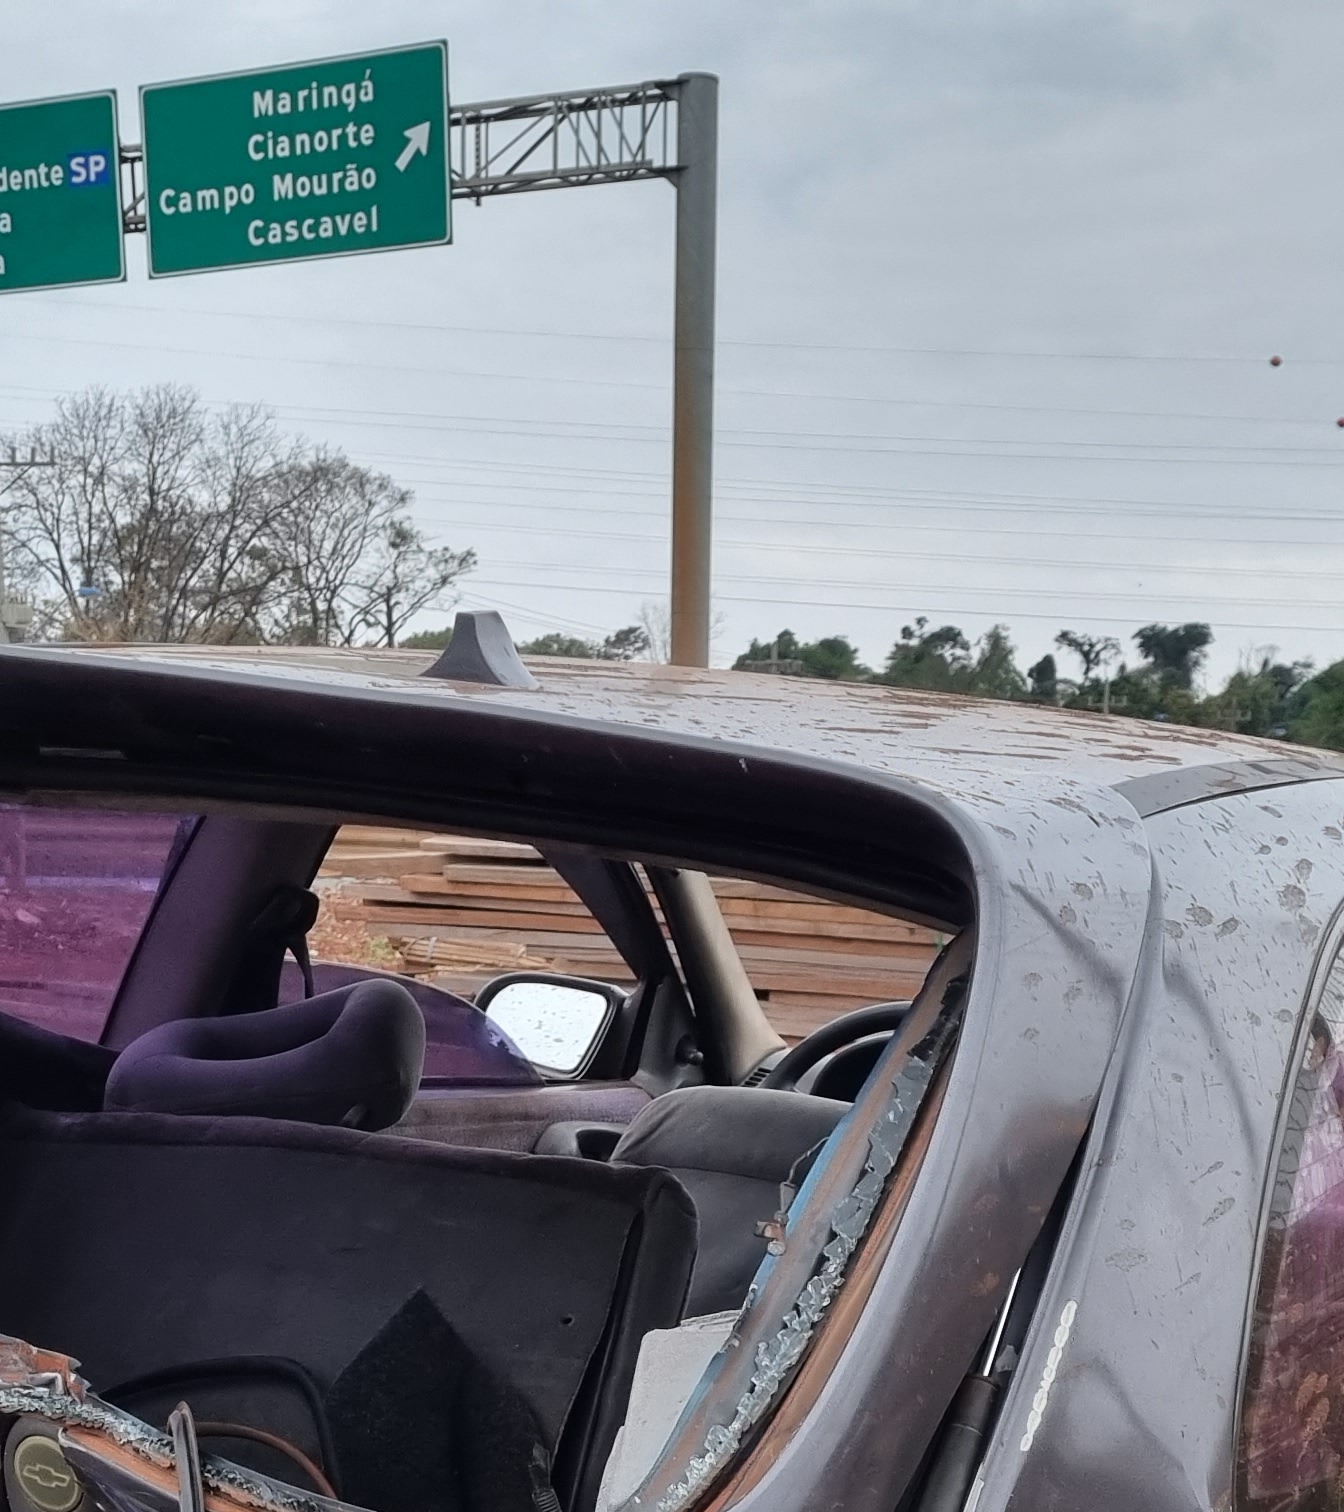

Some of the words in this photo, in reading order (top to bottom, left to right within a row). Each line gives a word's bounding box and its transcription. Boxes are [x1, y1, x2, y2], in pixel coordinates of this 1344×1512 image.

[253, 69, 375, 118] Maringá
[247, 121, 375, 161] Cianorte
[69, 155, 107, 184] SP
[159, 182, 256, 215] Campo
[272, 163, 377, 201] Mourão
[247, 204, 378, 246] Cascavel
